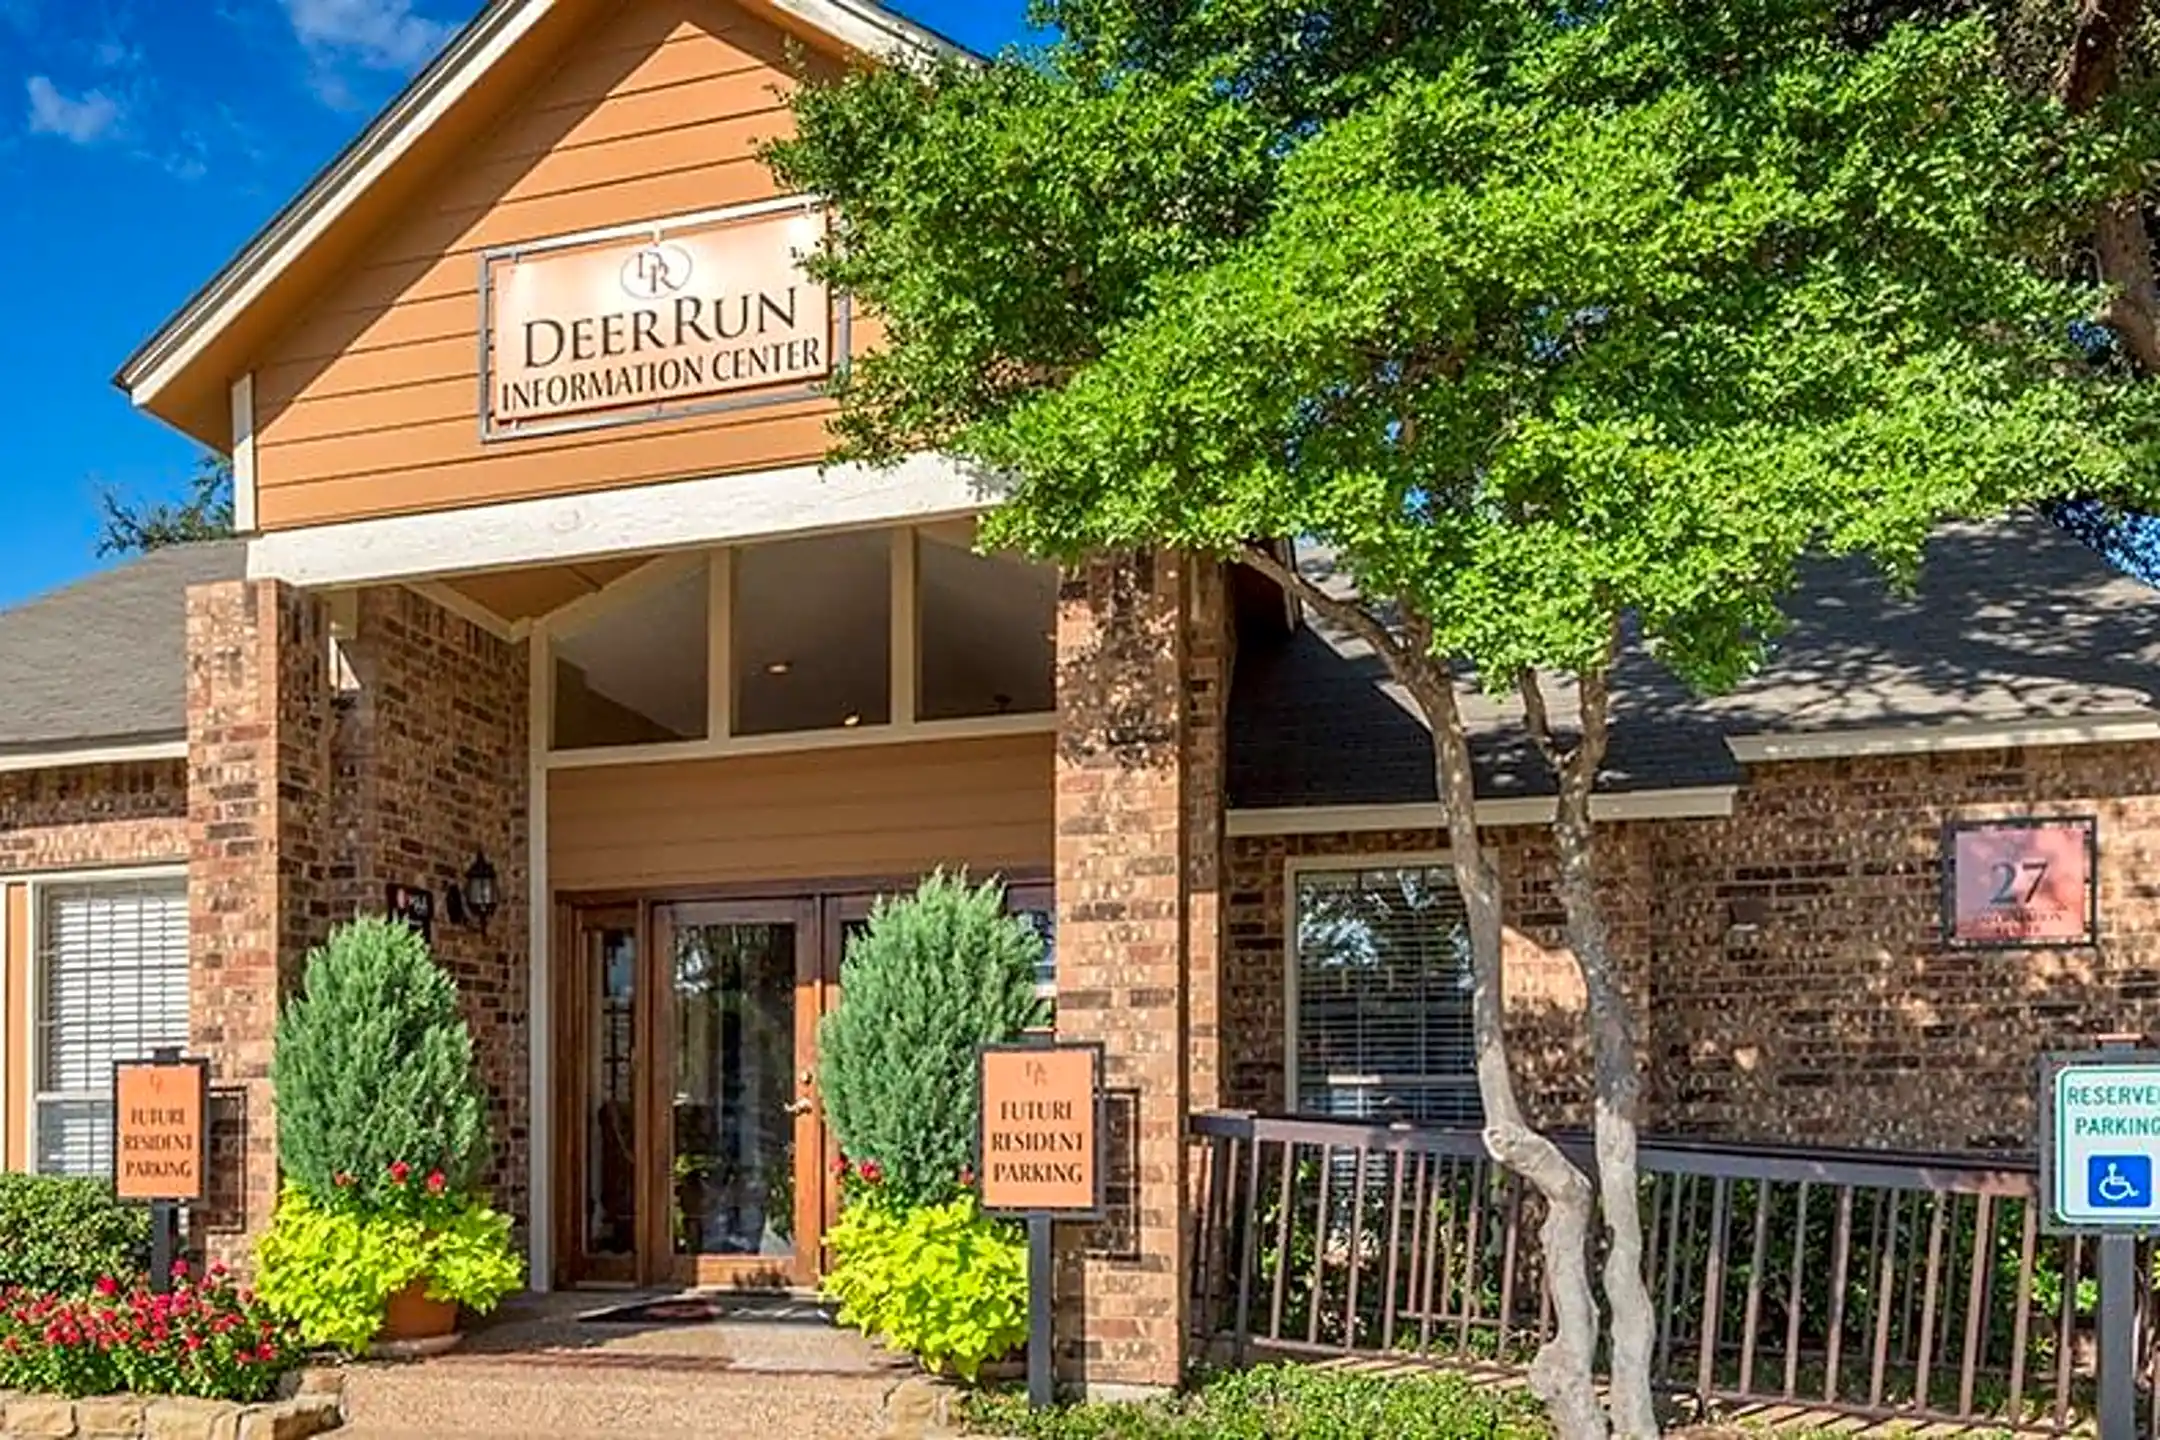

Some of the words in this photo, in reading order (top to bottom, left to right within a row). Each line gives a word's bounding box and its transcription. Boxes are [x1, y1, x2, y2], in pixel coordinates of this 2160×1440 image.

[502, 355, 703, 411] INFORMATION
[712, 337, 820, 382] CENTER
[1990, 860, 2048, 904] 27
[2066, 1085, 2160, 1106] RESERVE
[131, 1108, 185, 1126] FUTURE
[1000, 1100, 1072, 1121] FUTURE
[123, 1134, 193, 1151] RESIDENT
[991, 1132, 1083, 1152] RESIDENT
[125, 1160, 193, 1178] PARKING
[993, 1162, 1083, 1185] PARKING
